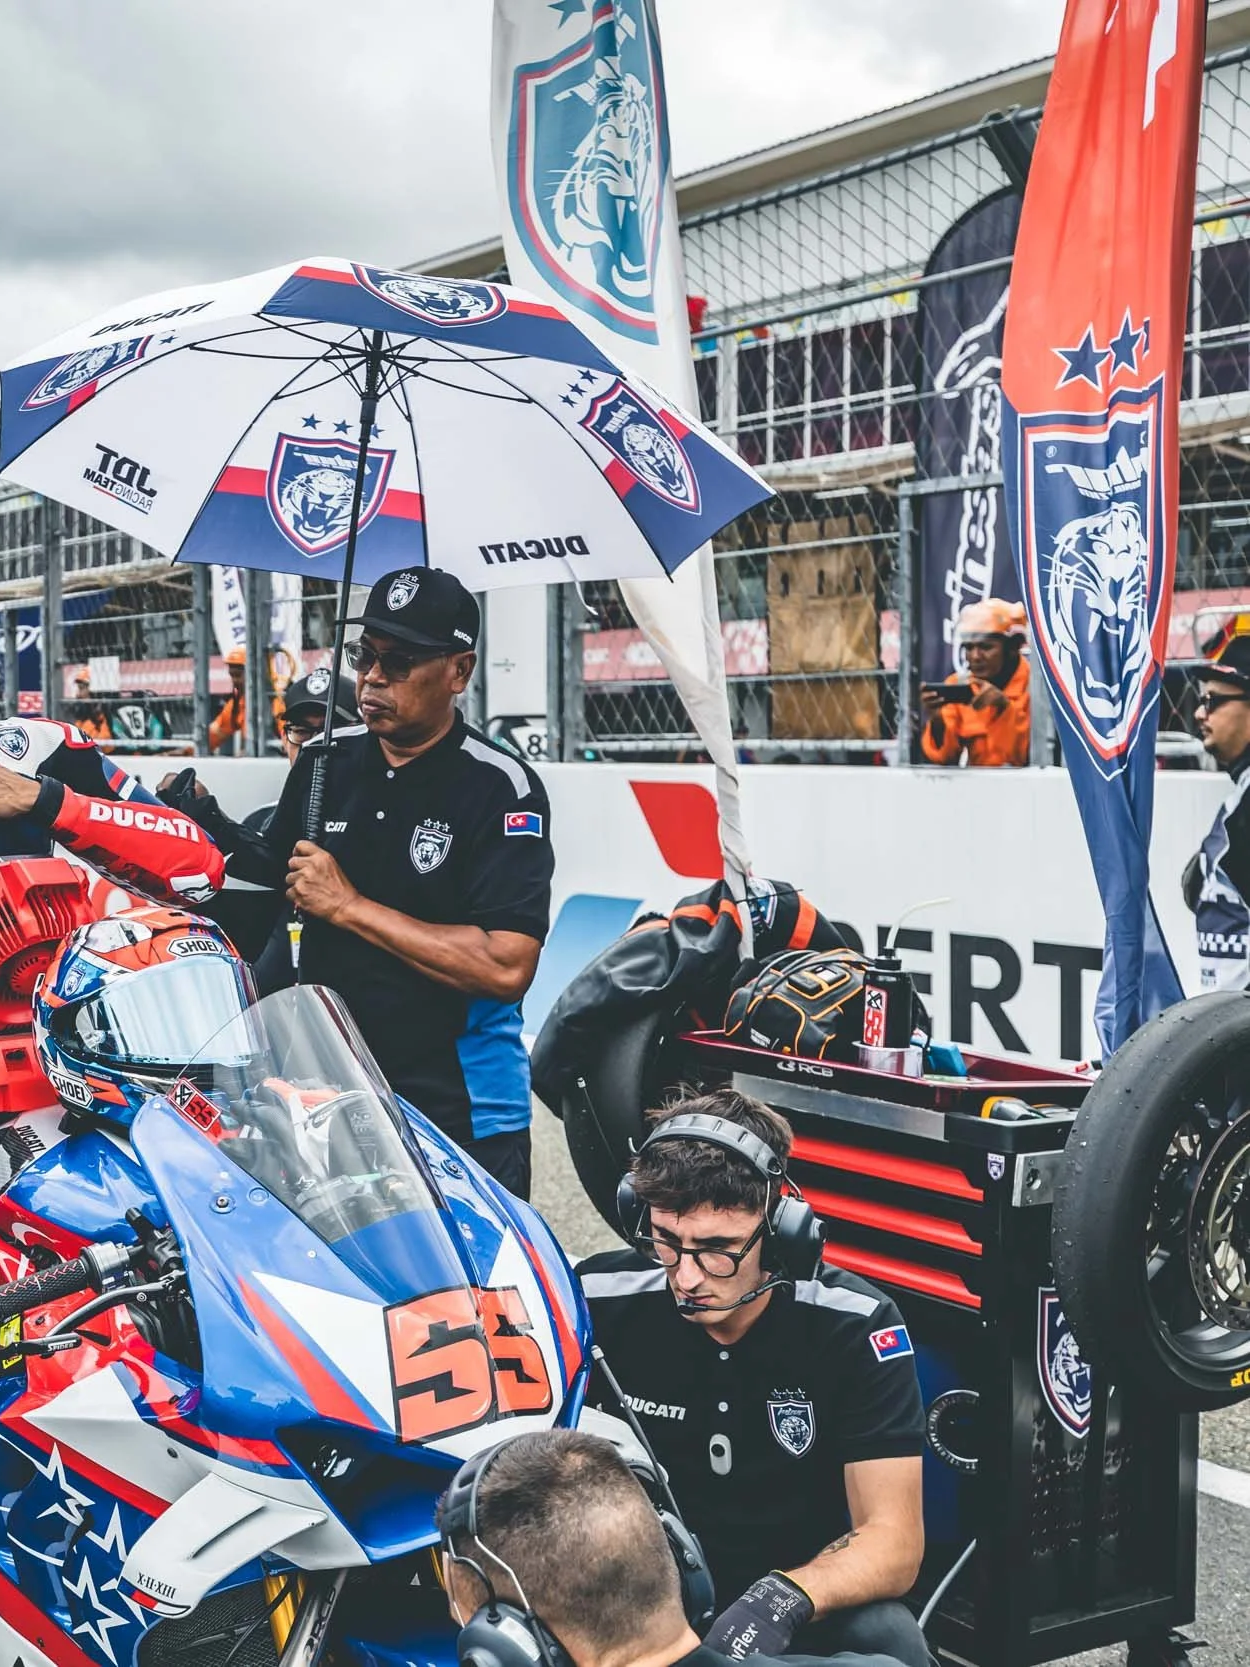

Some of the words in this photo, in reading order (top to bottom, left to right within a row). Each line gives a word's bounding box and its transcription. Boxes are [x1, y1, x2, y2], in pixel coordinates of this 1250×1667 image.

[88, 300, 215, 338] DUCATI
[91, 801, 200, 843] DUCATI
[324, 821, 348, 833] CATI
[177, 940, 218, 954] SHOEI
[799, 1062, 834, 1078] RCB
[52, 1075, 86, 1102] SHOEI
[16, 1125, 47, 1153] DUCATI
[383, 1285, 553, 1444] 55
[620, 1394, 686, 1420] DUCATI
